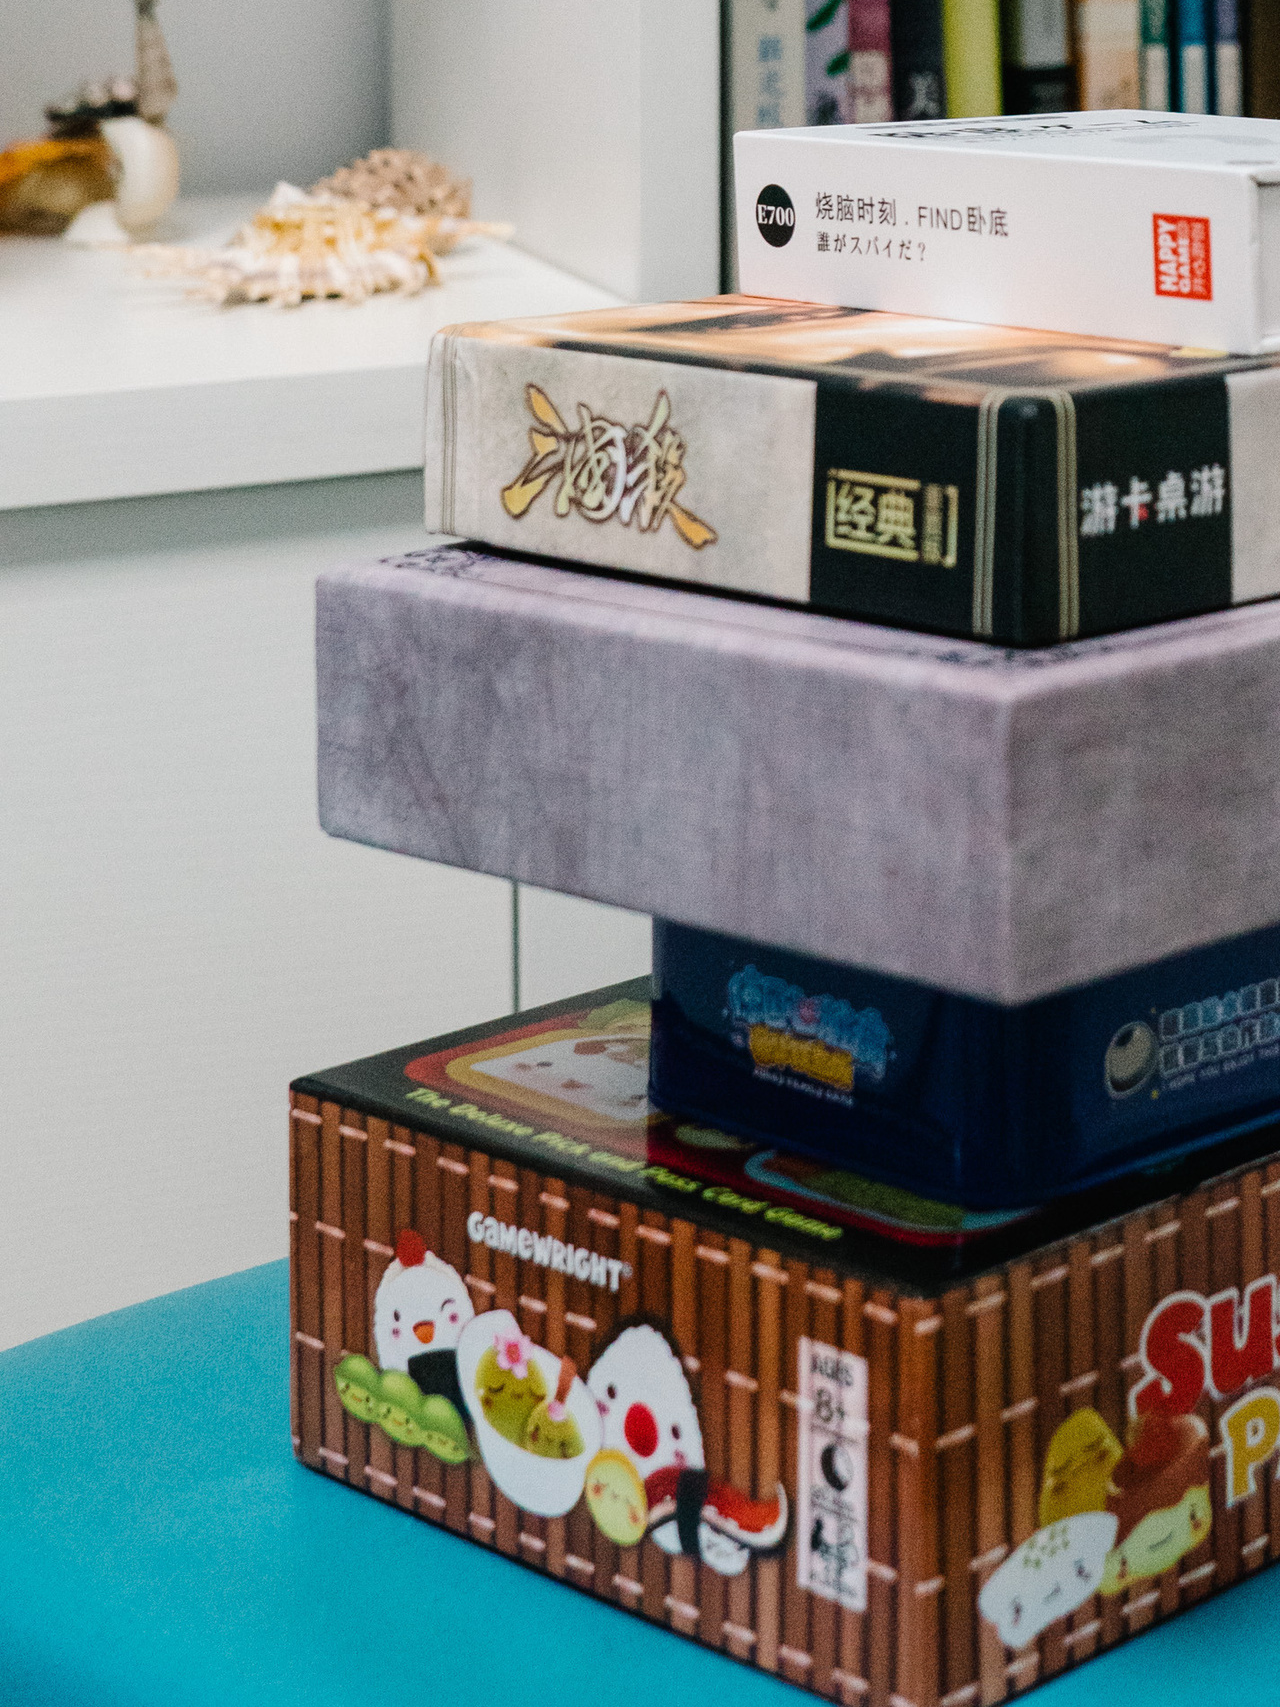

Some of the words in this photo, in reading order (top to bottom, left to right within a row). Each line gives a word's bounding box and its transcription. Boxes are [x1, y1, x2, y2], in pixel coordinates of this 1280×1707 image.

[757, 203, 795, 227] E700
[1158, 218, 1179, 292] HAPPY
[835, 480, 917, 549] 经典
[1080, 462, 1225, 537] 游卡桌游
[406, 1087, 452, 1108] The
[449, 1103, 534, 1136] Deluxe
[532, 1131, 591, 1156] Pick
[587, 1149, 647, 1173] and
[702, 1186, 771, 1214] Card
[764, 1205, 844, 1241] Game
